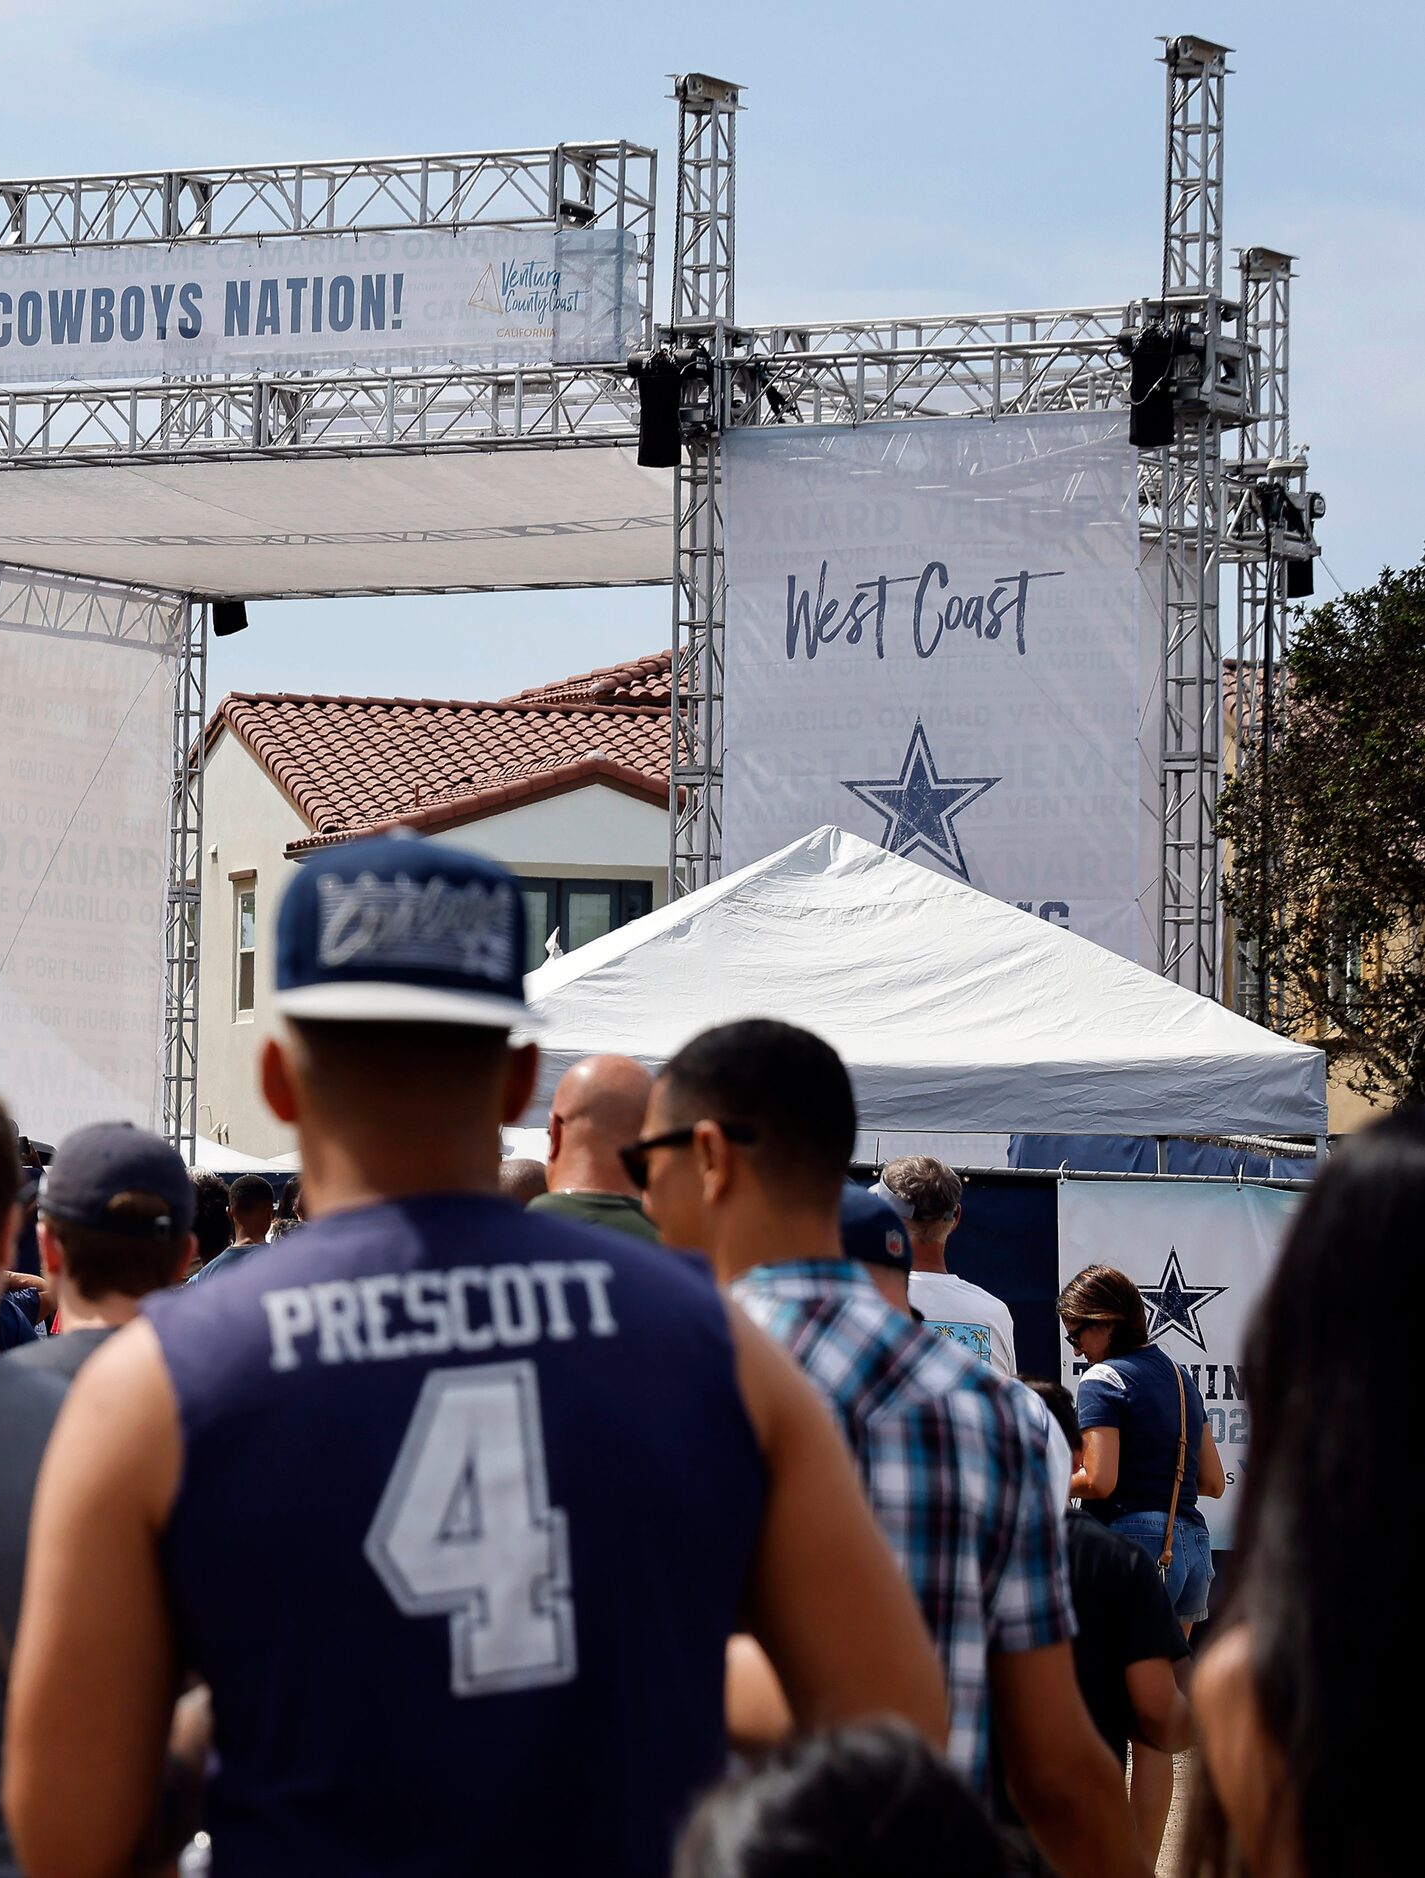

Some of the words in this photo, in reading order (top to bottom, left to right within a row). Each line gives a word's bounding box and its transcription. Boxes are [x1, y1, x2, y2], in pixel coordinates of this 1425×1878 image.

[224, 273, 404, 337] NATION!
[502, 258, 560, 296] Ventura
[497, 328, 556, 338] CALIFORNIA
[786, 559, 919, 660] West
[914, 560, 1065, 659] Coast
[261, 1261, 617, 1372] PRESCOTT
[365, 1360, 577, 1699] 4
